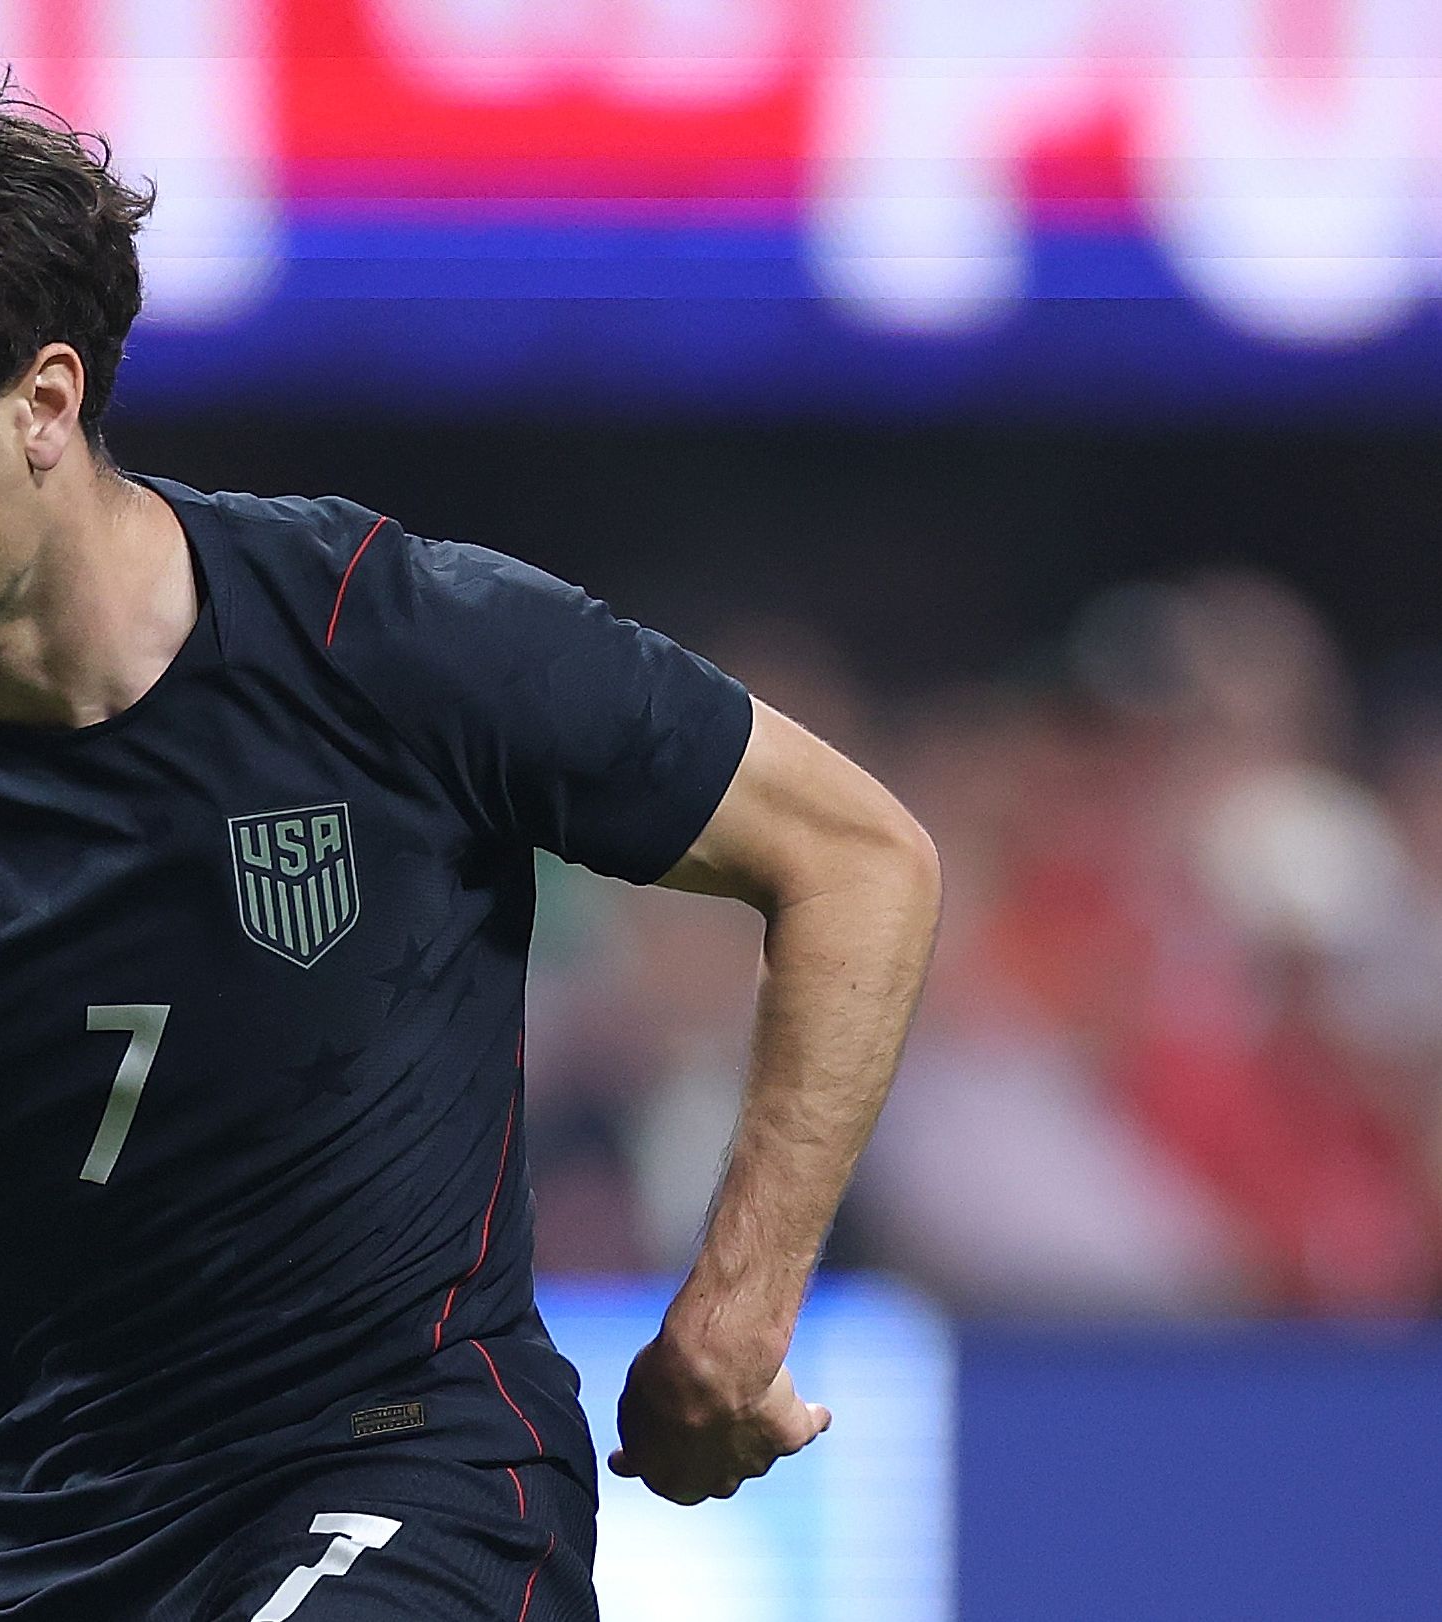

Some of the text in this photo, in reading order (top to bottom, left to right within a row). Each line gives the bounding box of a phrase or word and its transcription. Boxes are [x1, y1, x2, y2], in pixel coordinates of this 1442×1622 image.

[239, 814, 342, 877] USA
[79, 1004, 171, 1185] 7
[250, 1512, 403, 1622] 7
